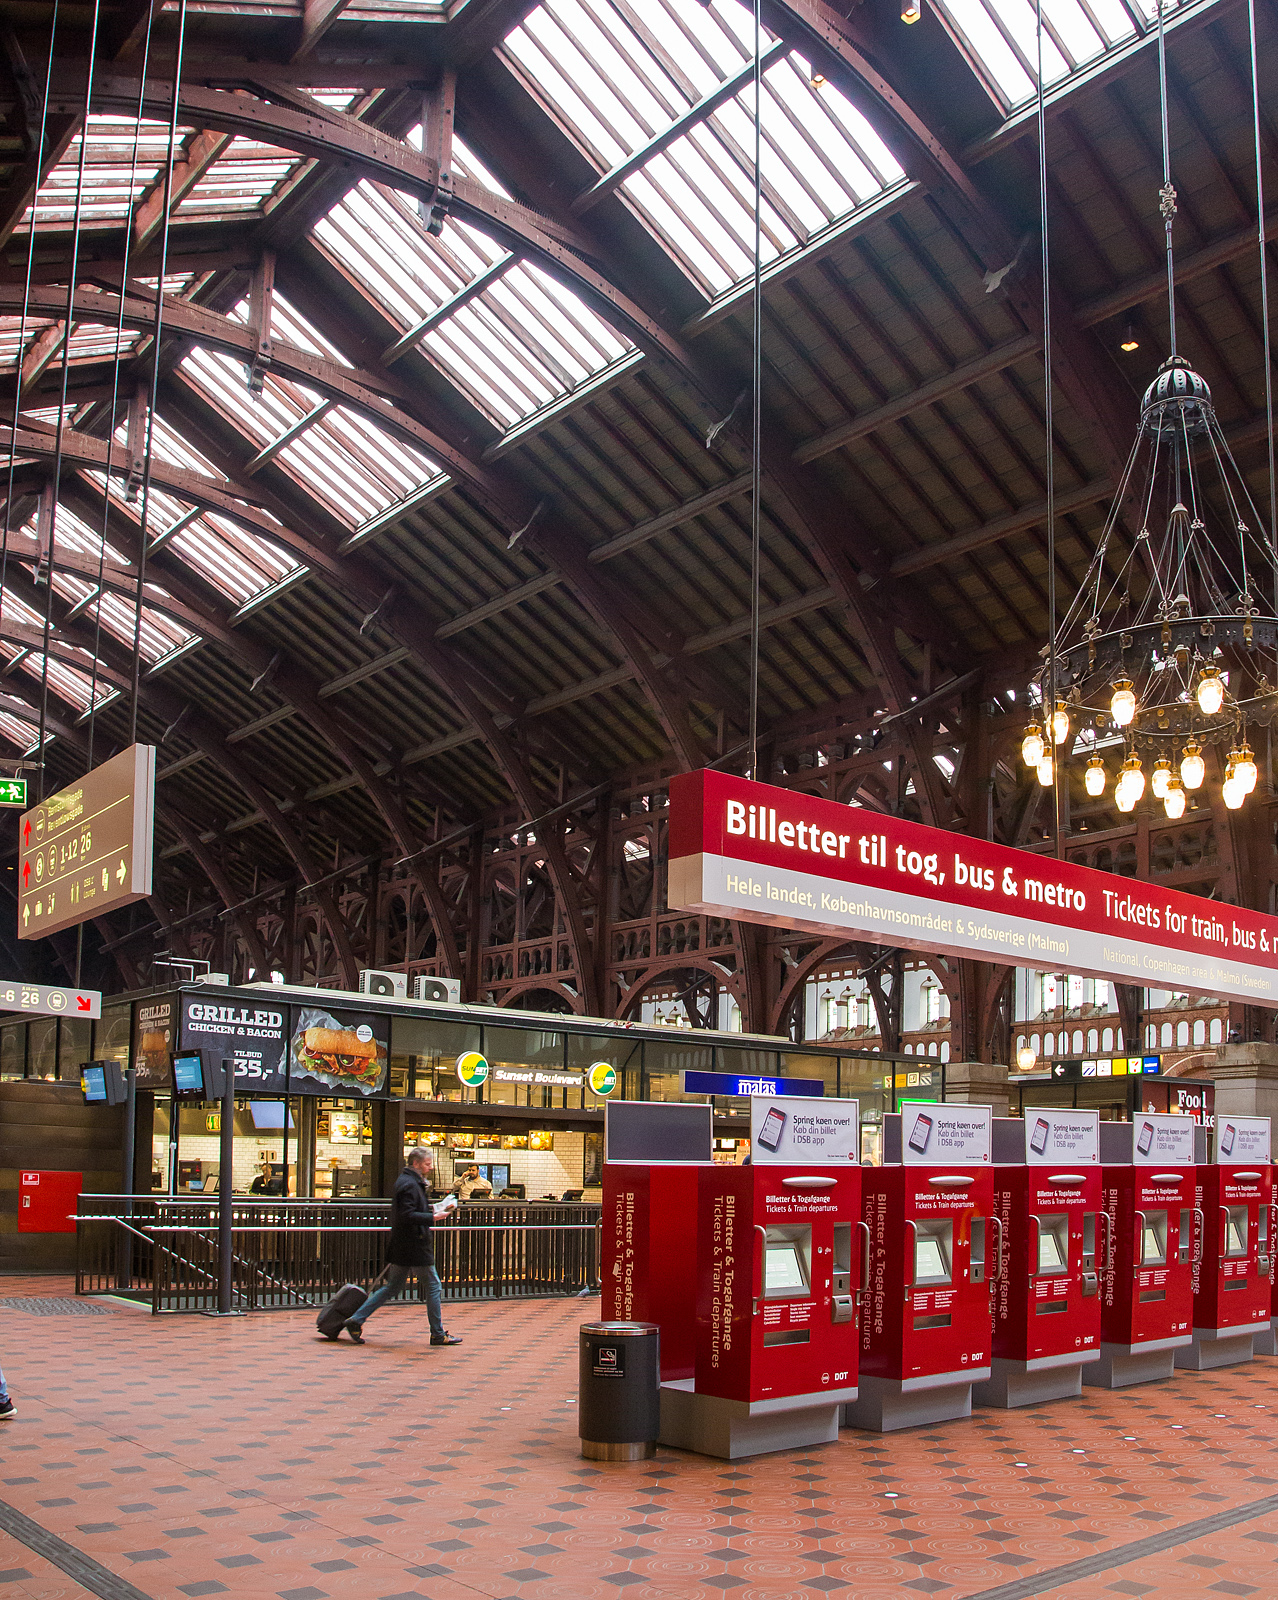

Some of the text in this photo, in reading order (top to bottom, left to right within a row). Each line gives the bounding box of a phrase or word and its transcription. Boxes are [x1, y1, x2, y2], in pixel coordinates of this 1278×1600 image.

[81, 832, 92, 854] 26
[726, 800, 1086, 911] Billetter til tog, bus & metro
[726, 875, 1070, 956] Hele landet, Københavnsområdet & Sydsverige (Malmø)
[1103, 890, 1270, 952] Tickets for train, bus &
[1103, 948, 1272, 991] National, Copenhagen area & Malmö (Sweden)
[21, 991, 40, 1005] 26
[139, 1004, 171, 1020] GRILLED
[188, 1004, 283, 1028] GRILLED
[188, 1022, 282, 1039] CHICKEN & BACON
[234, 1050, 262, 1058] TILBUD
[234, 1059, 273, 1080] 35,-
[495, 1070, 582, 1085] Sunset Boulevard
[738, 1078, 776, 1095] matas
[1177, 1090, 1206, 1108] Food
[793, 1115, 850, 1126] Spring køen over!
[938, 1121, 956, 1129] Spring
[957, 1121, 970, 1129] køen
[794, 1125, 836, 1135] Køb din billet
[951, 1130, 959, 1138] din
[960, 1130, 974, 1138] billet
[812, 1137, 825, 1145] app
[766, 1195, 790, 1203] Billetter
[797, 1196, 831, 1204] Togafgange
[766, 1205, 786, 1213] Tickets
[809, 1204, 838, 1213] departures
[616, 1193, 624, 1236] Tickets
[1109, 1189, 1117, 1232] Billetter
[616, 1240, 624, 1248] &
[624, 1193, 634, 1322] Billetter & Togafgan
[875, 1194, 886, 1334] Billetter & Togafgange
[1000, 1192, 1011, 1319] Billetter & Togafgange
[711, 1195, 723, 1368] Tickets & Train departures
[722, 1195, 735, 1350] Billetter & Togafgange
[1106, 1245, 1116, 1306] Togafgange
[614, 1287, 624, 1321] depar
[863, 1287, 873, 1350] departures
[1084, 1336, 1094, 1344] DOT
[972, 1352, 983, 1361] DOT
[834, 1372, 848, 1380] DOT
